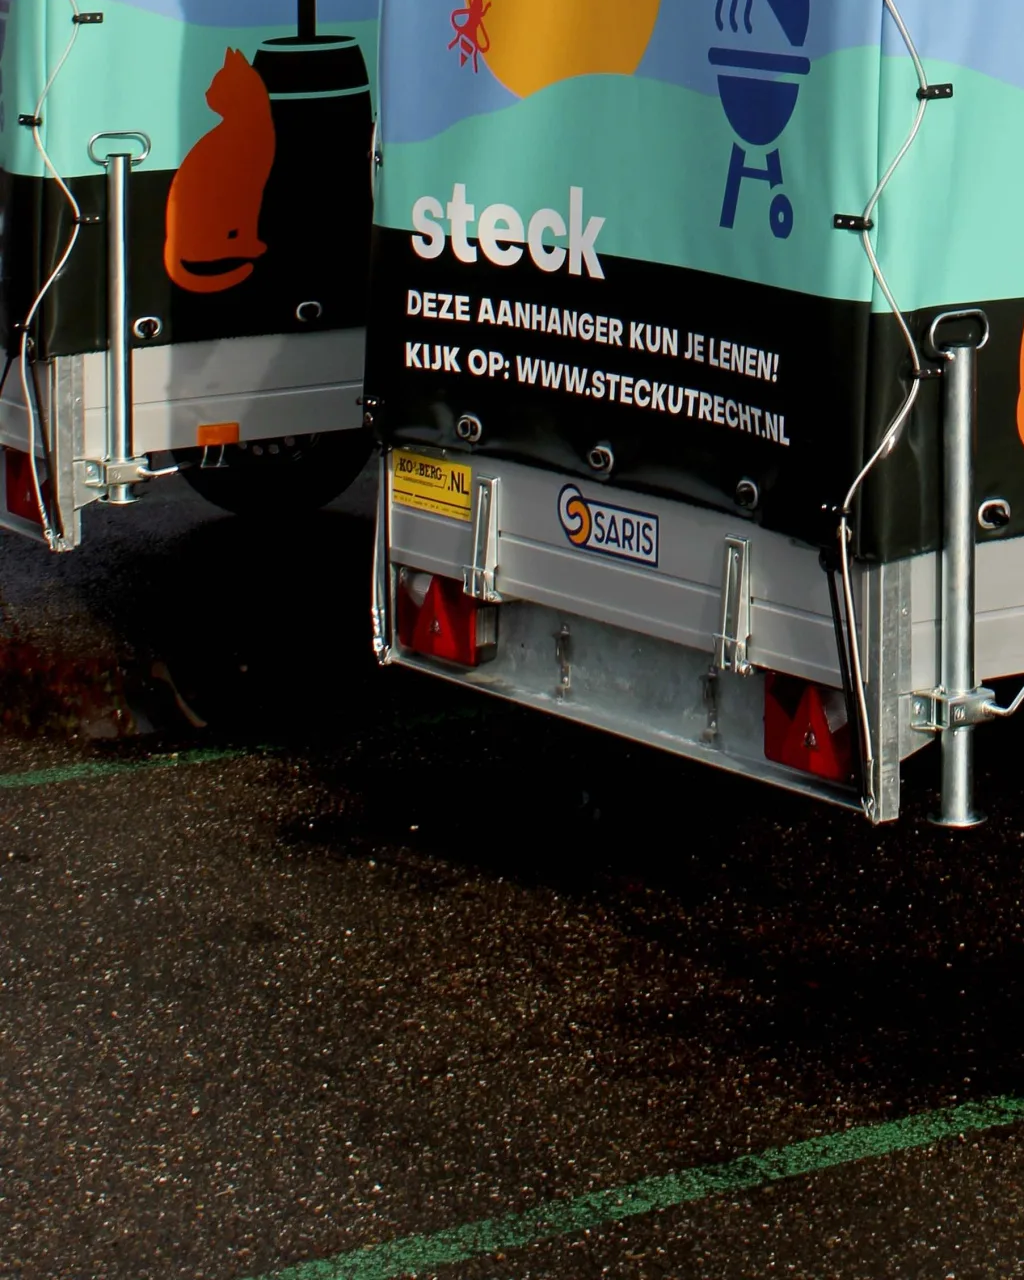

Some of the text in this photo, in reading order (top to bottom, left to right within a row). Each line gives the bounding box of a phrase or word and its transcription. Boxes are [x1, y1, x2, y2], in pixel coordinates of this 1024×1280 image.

[411, 182, 606, 279] steck
[406, 289, 779, 383] DEZE AANHANGER KUN JE LENEN!
[405, 341, 790, 446] KIJK OP: WWW.STECKUTRECHT.NL
[594, 510, 653, 555] SARIS
